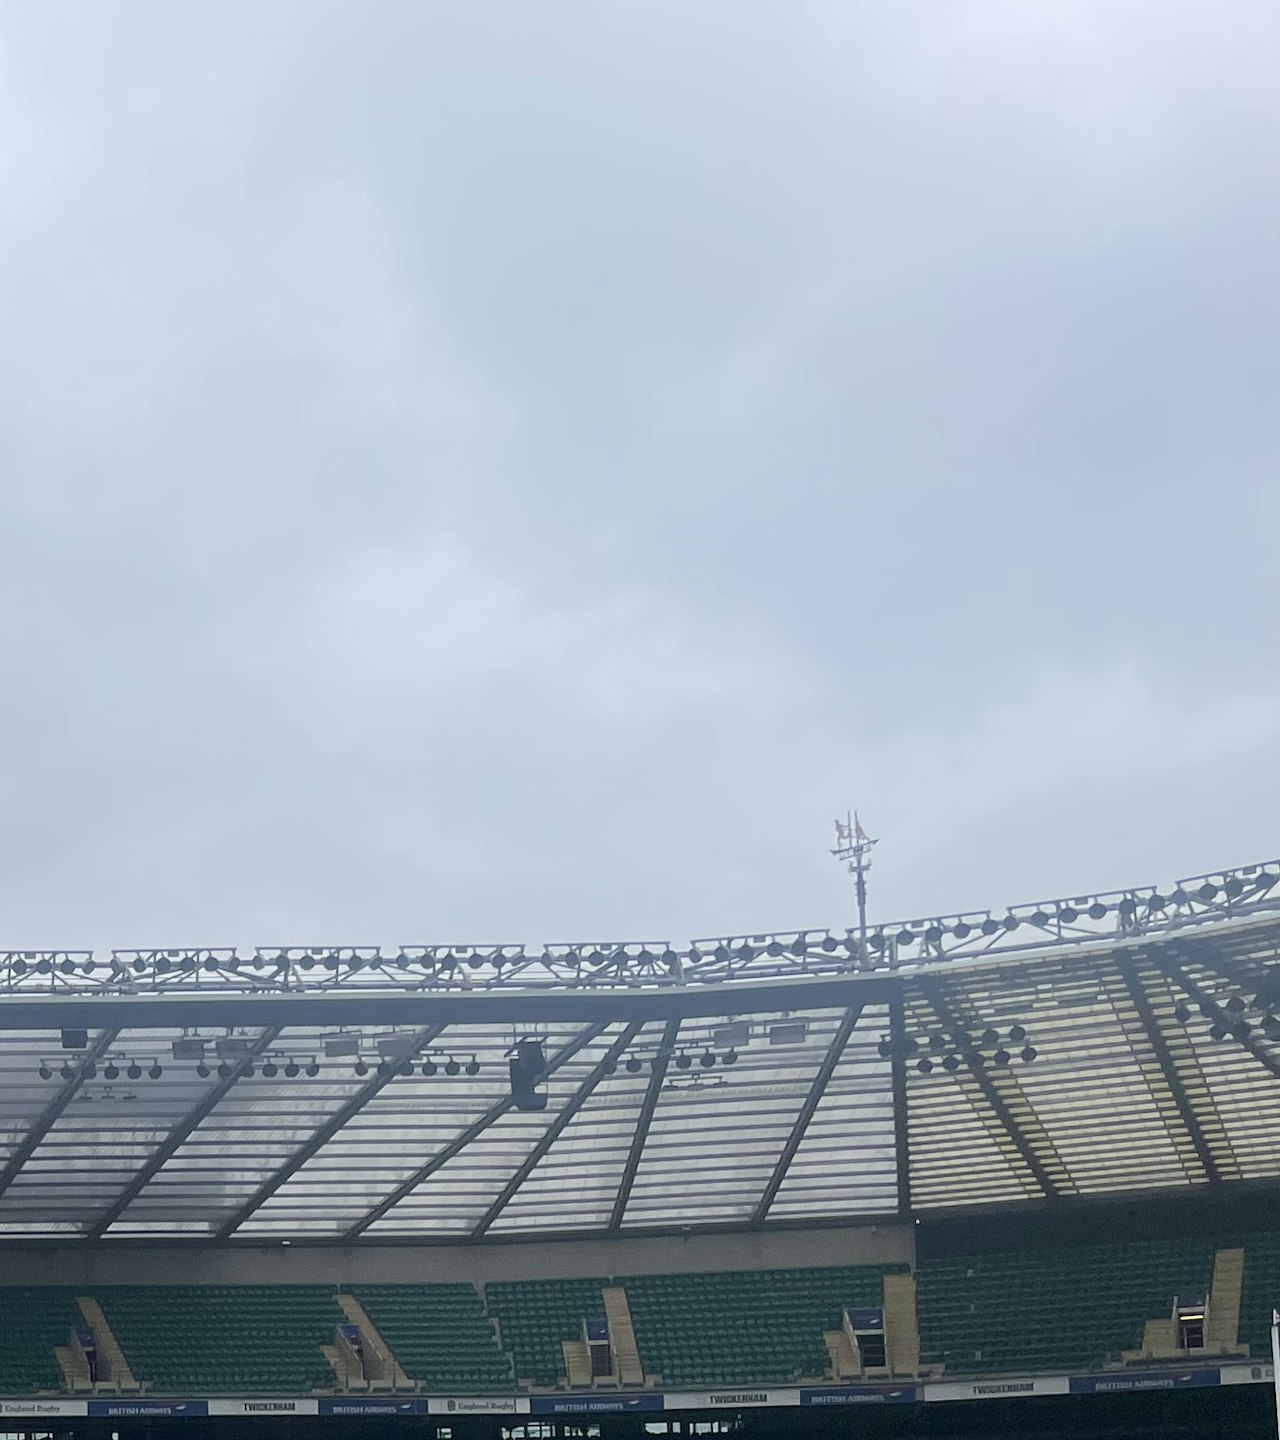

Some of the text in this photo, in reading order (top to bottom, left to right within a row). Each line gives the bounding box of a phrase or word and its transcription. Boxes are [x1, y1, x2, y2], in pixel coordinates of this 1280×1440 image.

[972, 1382, 1034, 1394] TWICKENHAM
[710, 1394, 767, 1404] TWICKENHAM
[5, 1405, 60, 1413] England Rugby
[244, 1402, 296, 1411] TWICKENHAM
[458, 1402, 515, 1410] England Rugby
